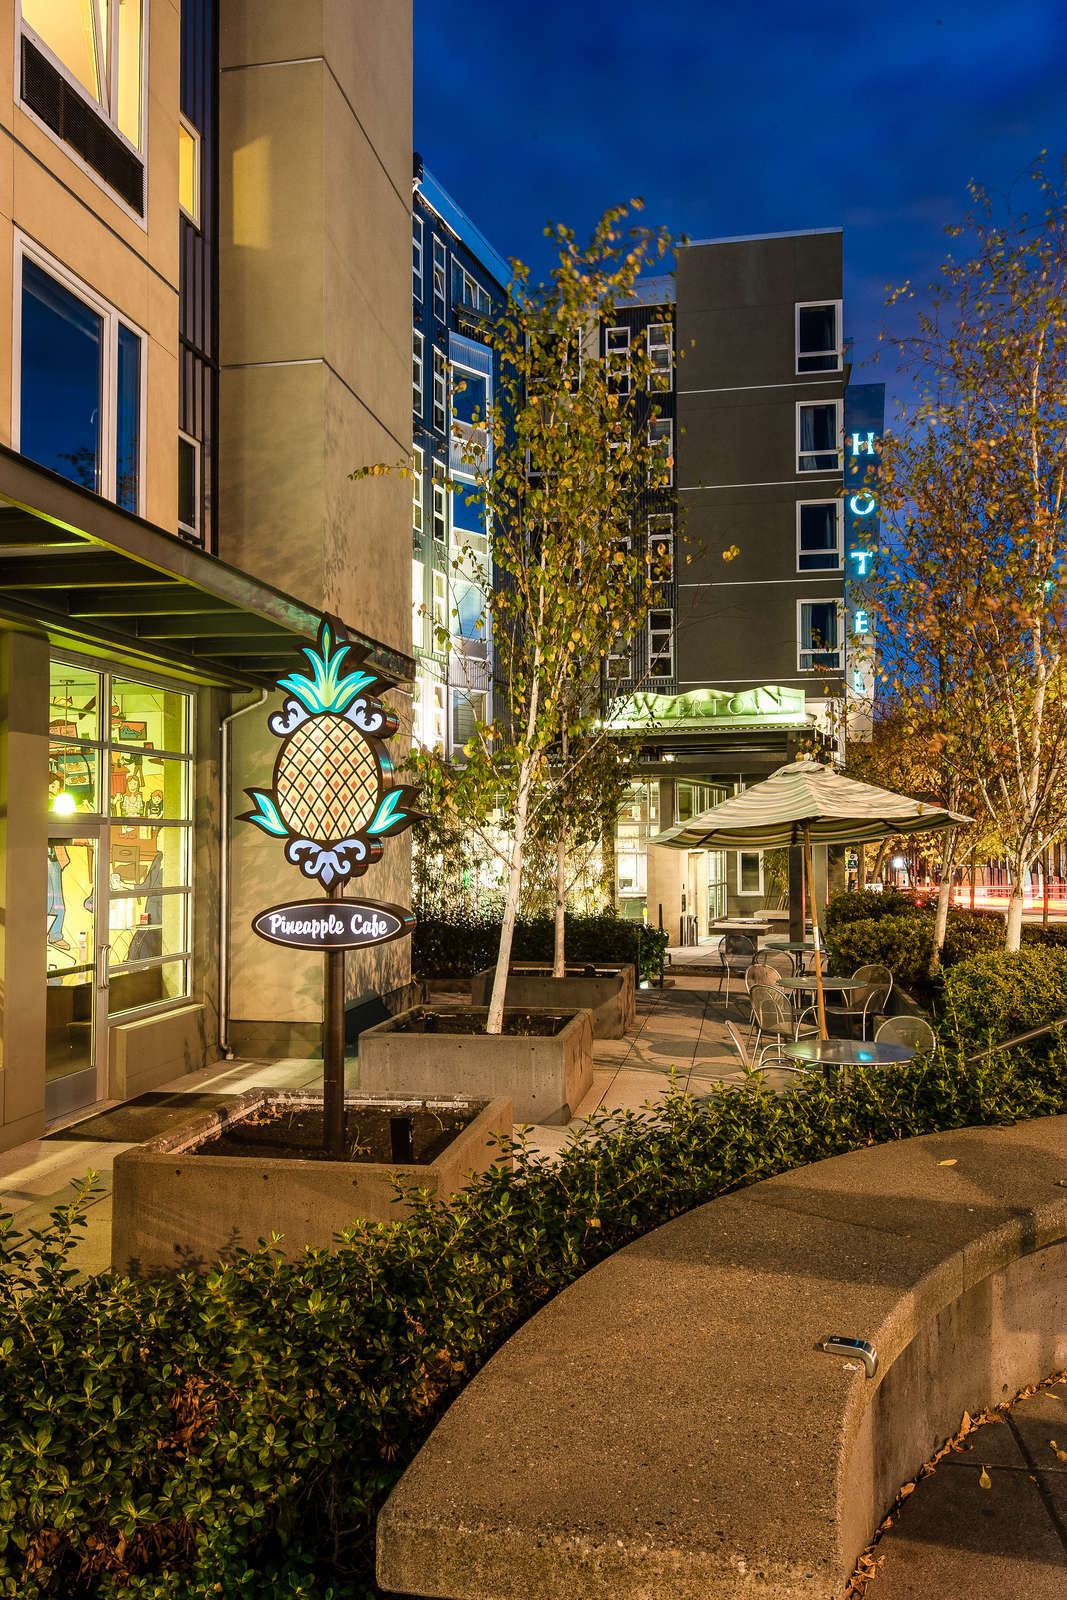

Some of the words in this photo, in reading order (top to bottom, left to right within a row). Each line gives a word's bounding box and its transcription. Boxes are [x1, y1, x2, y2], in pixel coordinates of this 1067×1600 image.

[850, 432, 875, 695] HOTEL
[612, 695, 797, 720] ATERTON
[269, 914, 344, 939] Pineapple
[350, 914, 388, 938] Cafe
